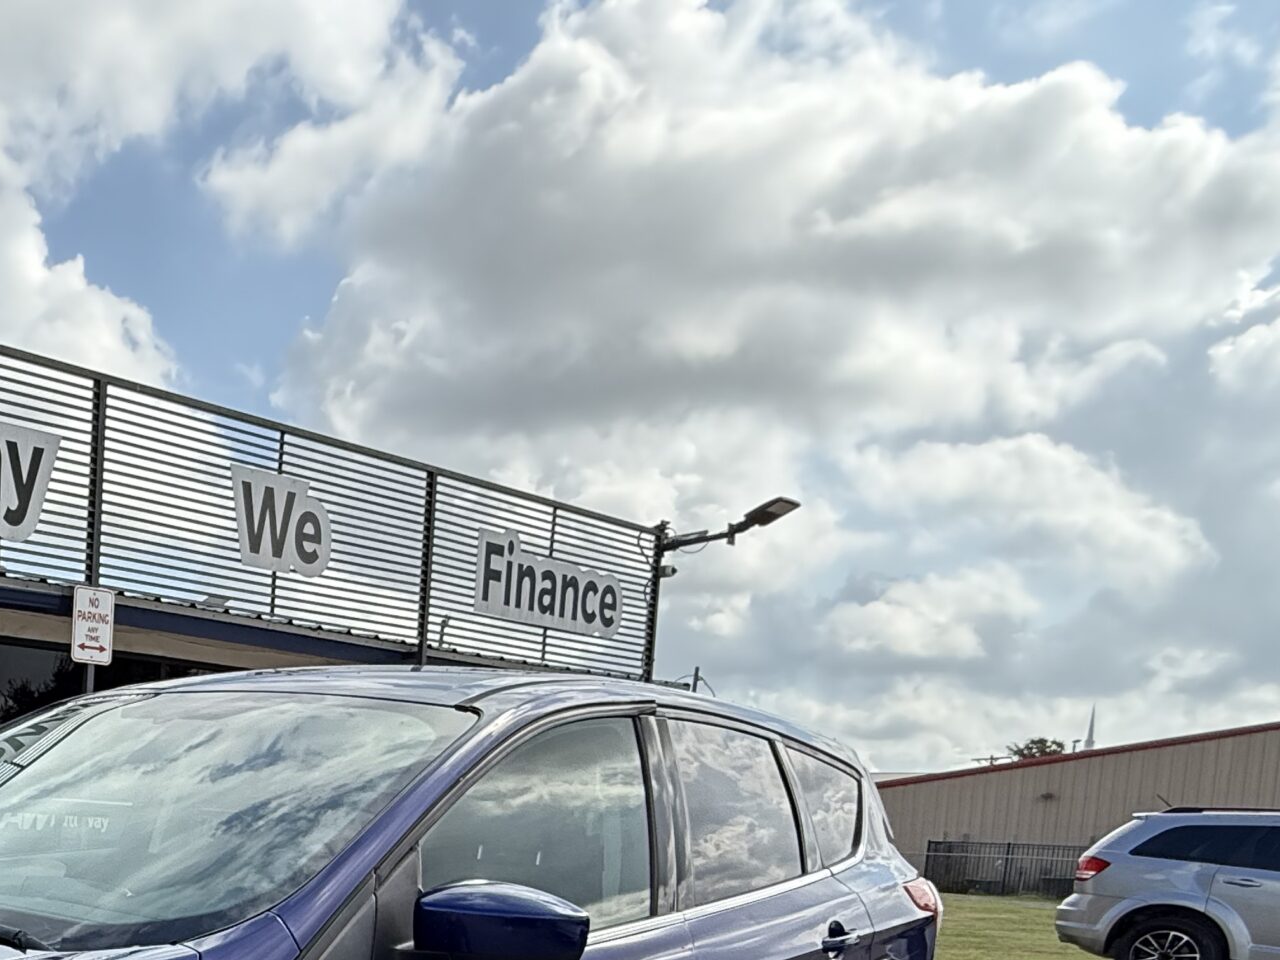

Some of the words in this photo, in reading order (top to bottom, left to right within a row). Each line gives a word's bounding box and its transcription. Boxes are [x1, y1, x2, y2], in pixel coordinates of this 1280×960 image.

[241, 480, 321, 564] We
[481, 540, 618, 628] Finance
[89, 597, 99, 609] NO
[77, 610, 109, 625] PARKING
[85, 634, 100, 643] TIME
